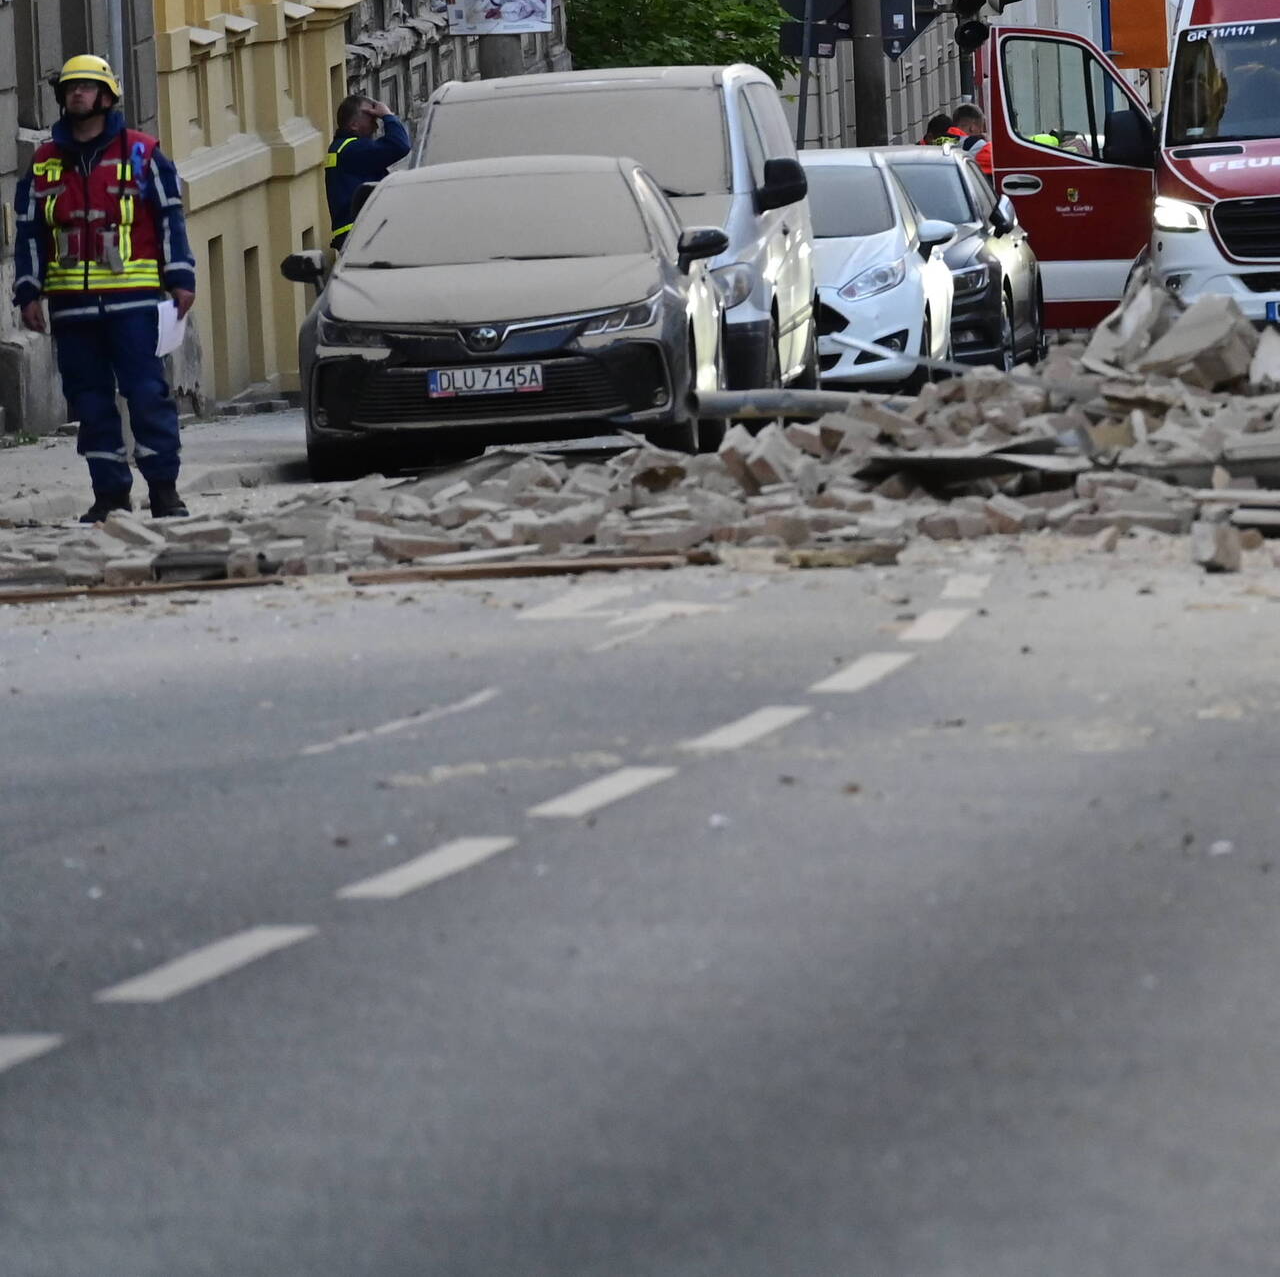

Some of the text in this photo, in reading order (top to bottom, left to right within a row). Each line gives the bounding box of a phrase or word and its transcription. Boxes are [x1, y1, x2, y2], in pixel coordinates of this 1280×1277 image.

[1186, 25, 1256, 42] GR 11/11/1
[439, 369, 476, 391] DLU
[481, 365, 540, 388] 7145A
